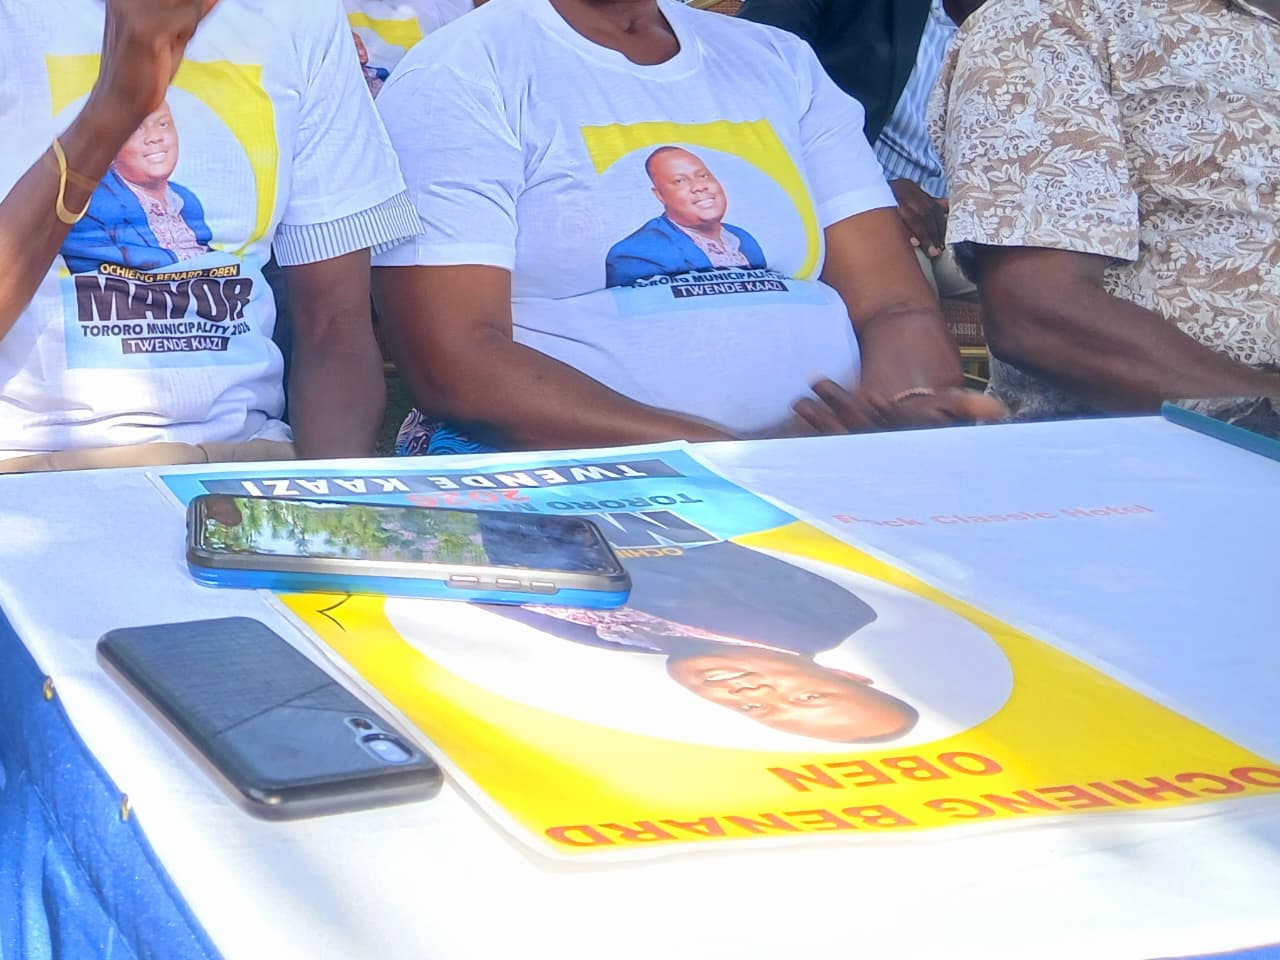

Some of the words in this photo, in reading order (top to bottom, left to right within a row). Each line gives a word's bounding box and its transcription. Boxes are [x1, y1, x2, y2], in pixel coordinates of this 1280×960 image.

[100, 263, 153, 283] OCHIENG
[74, 275, 254, 322] MAYOR
[676, 282, 745, 297] TWENDE
[746, 280, 784, 292] KAAZI
[81, 324, 143, 337] TORORO
[147, 322, 229, 336] MUNICIPALITY
[128, 338, 190, 352] TWENDE
[191, 337, 222, 350] KAAZI
[427, 464, 647, 489] TWENDE
[241, 477, 411, 497] KAAZI
[546, 493, 704, 511] TORORO
[930, 511, 1057, 525] Classic
[1059, 504, 1154, 518] Hotel
[767, 751, 1003, 793] OBEN
[923, 767, 1280, 818] OCHIENG
[545, 804, 917, 847] BENARD
